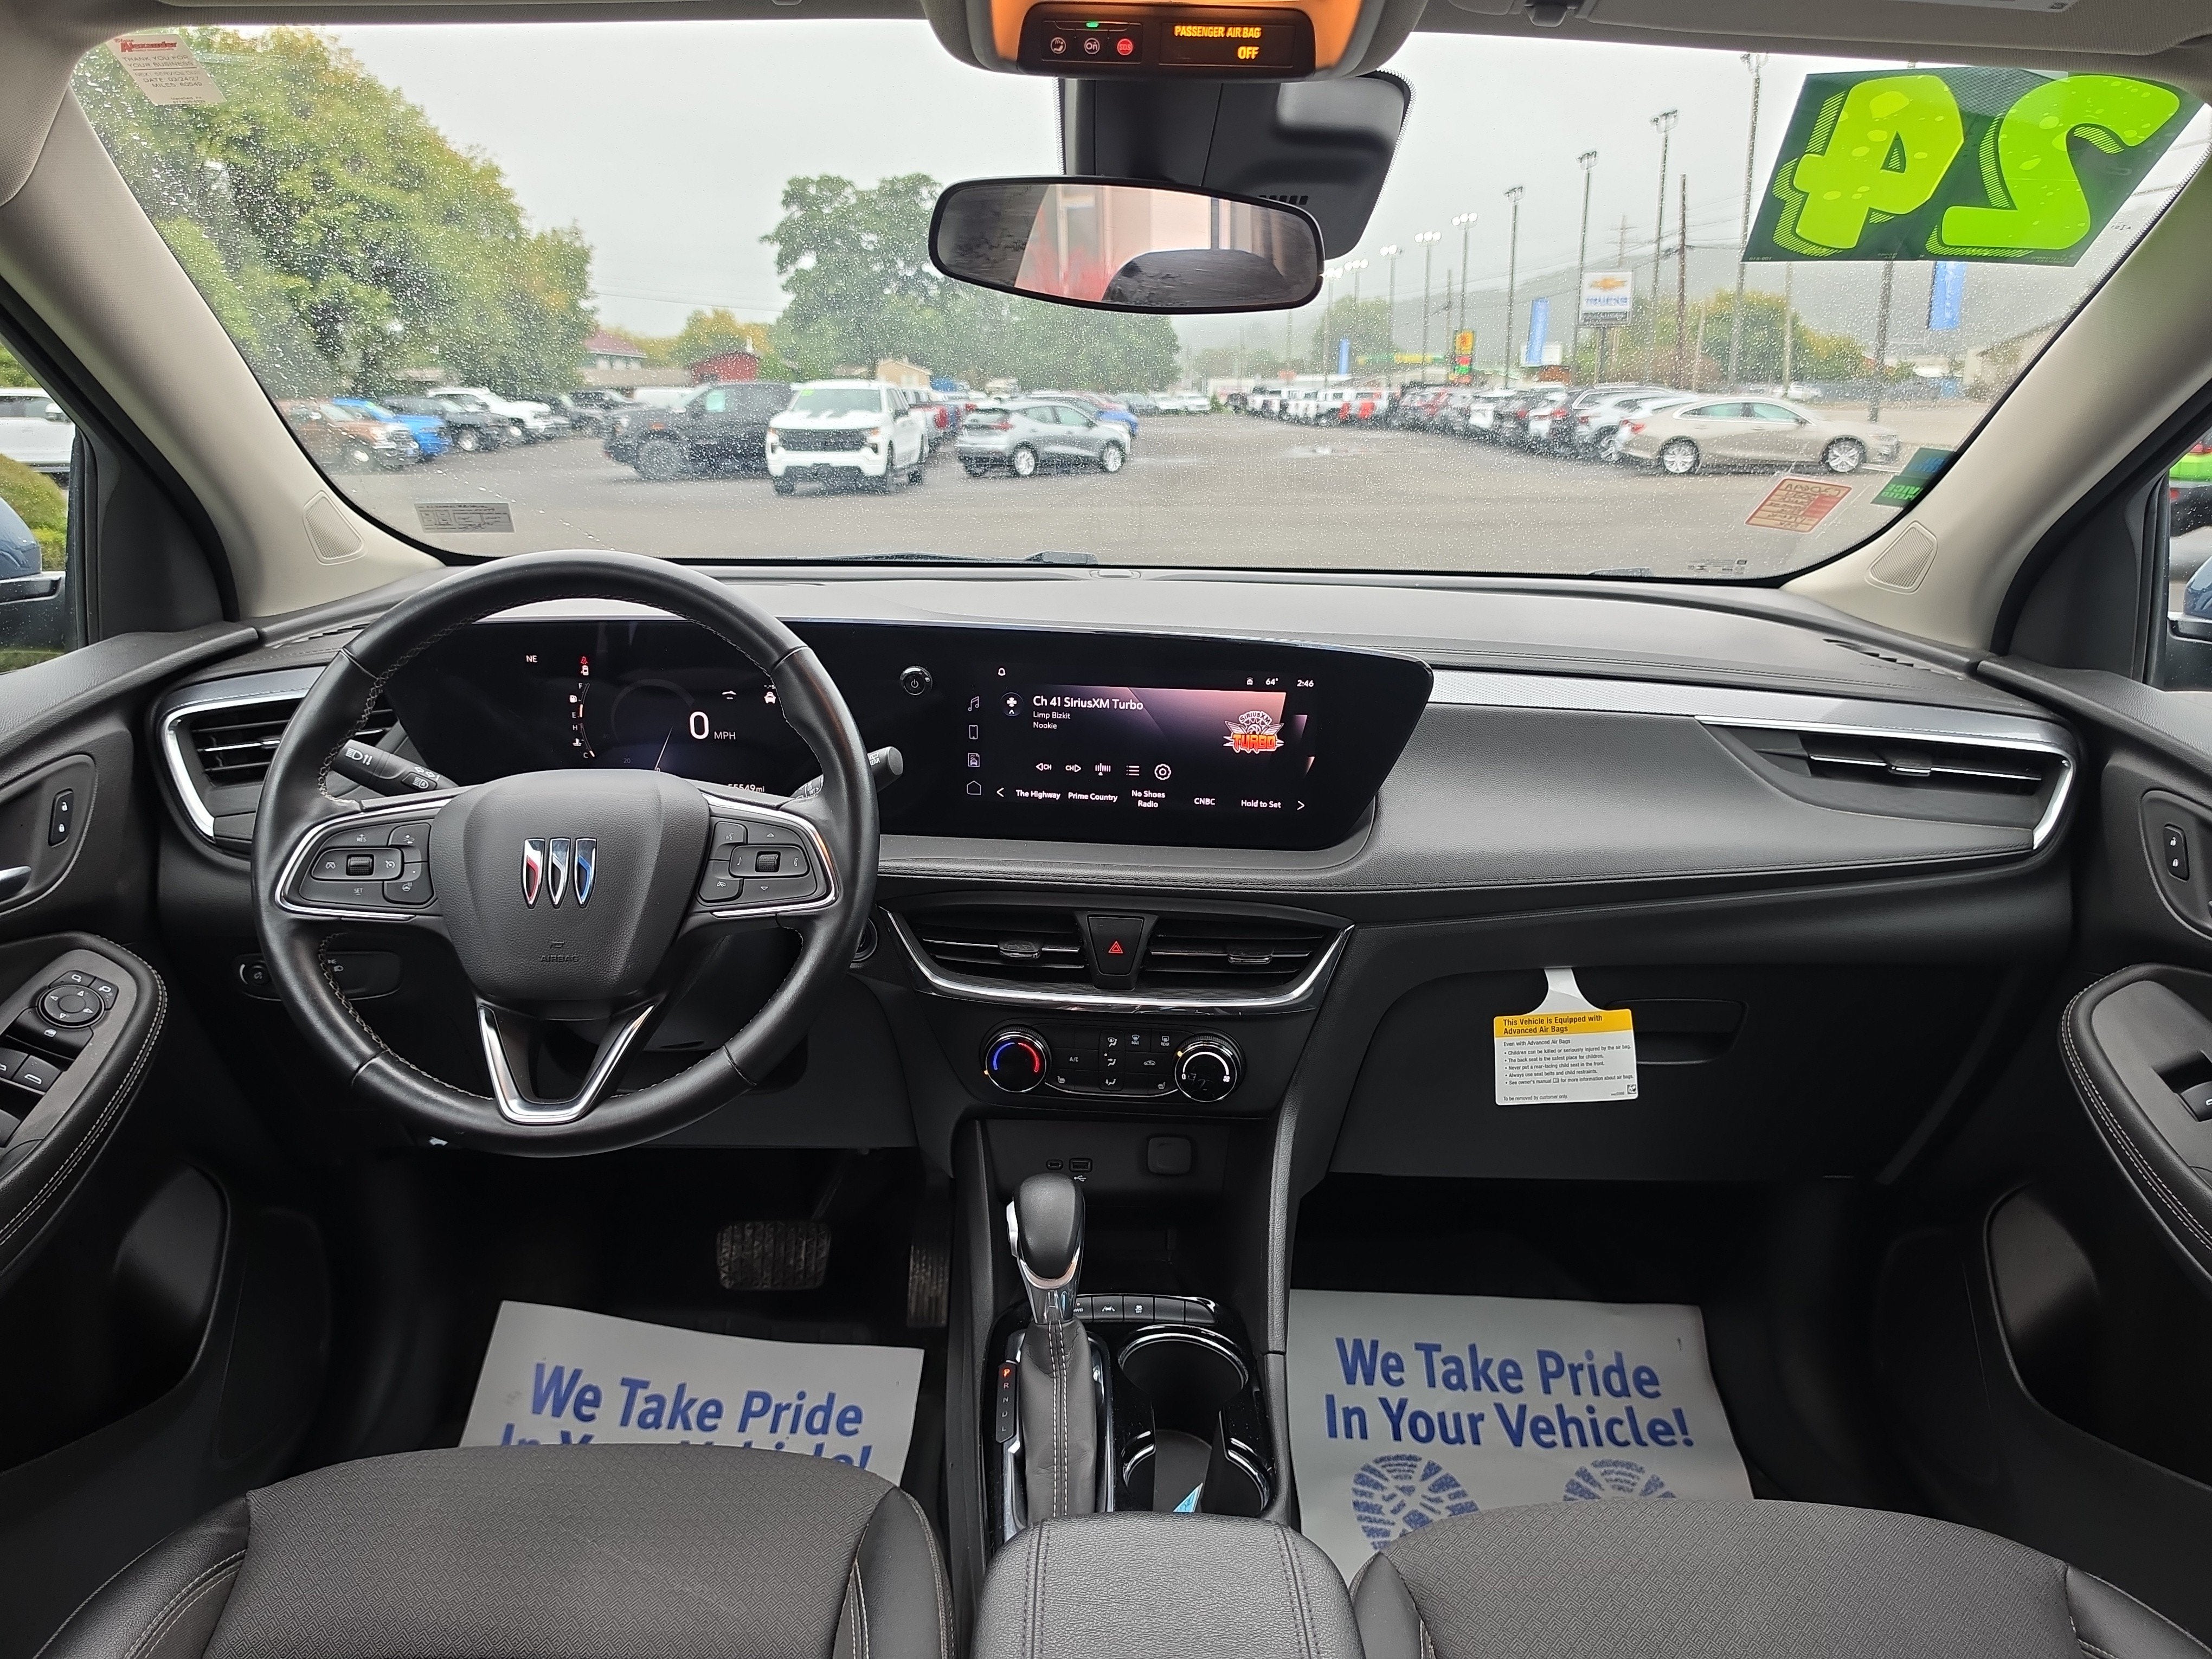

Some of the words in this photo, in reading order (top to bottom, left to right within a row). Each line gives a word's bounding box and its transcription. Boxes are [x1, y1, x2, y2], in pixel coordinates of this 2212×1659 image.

[1174, 25, 1225, 37] PASSENGER
[1226, 27, 1242, 37] AIR
[1243, 27, 1262, 38] BAG
[1119, 43, 1131, 52] SOS
[1238, 46, 1259, 60] OFF
[526, 655, 538, 663] NE
[1297, 679, 1314, 687] 2:46
[1033, 696, 1047, 706] Ch
[1050, 696, 1061, 707] 41
[1064, 697, 1110, 709] SiriusXM
[1112, 698, 1144, 710] Turbo
[1033, 711, 1050, 720] Limp
[1052, 711, 1071, 720] Bizkit
[1239, 712, 1271, 725] SIRIUSXM
[689, 711, 709, 740] 0
[1033, 722, 1058, 730] Nookie
[714, 731, 736, 740] MPH
[1232, 734, 1276, 752] TURBO
[1016, 789, 1029, 798] The
[1031, 790, 1061, 800] Highway
[1068, 792, 1089, 800] Prime
[1090, 793, 1118, 803] Country
[1131, 789, 1142, 798] No
[1143, 790, 1166, 798] Shoes
[1137, 800, 1159, 808] Radio
[1241, 799, 1258, 807] Hold
[1269, 800, 1281, 808] Set
[1554, 1015, 1586, 1025] Equipped
[1503, 1026, 1537, 1034] Advanced
[1551, 1025, 1568, 1033] Bags
[1335, 1336, 1405, 1388] We
[1414, 1342, 1525, 1393] Take
[1536, 1348, 1662, 1399] Pride
[1003, 1368, 1011, 1378] P
[531, 1361, 603, 1423] We
[620, 1377, 725, 1432] Take
[737, 1390, 864, 1438] Pride
[1324, 1394, 1368, 1440] In
[1378, 1397, 1485, 1446] Your
[1493, 1402, 1695, 1449] Vehicle!
